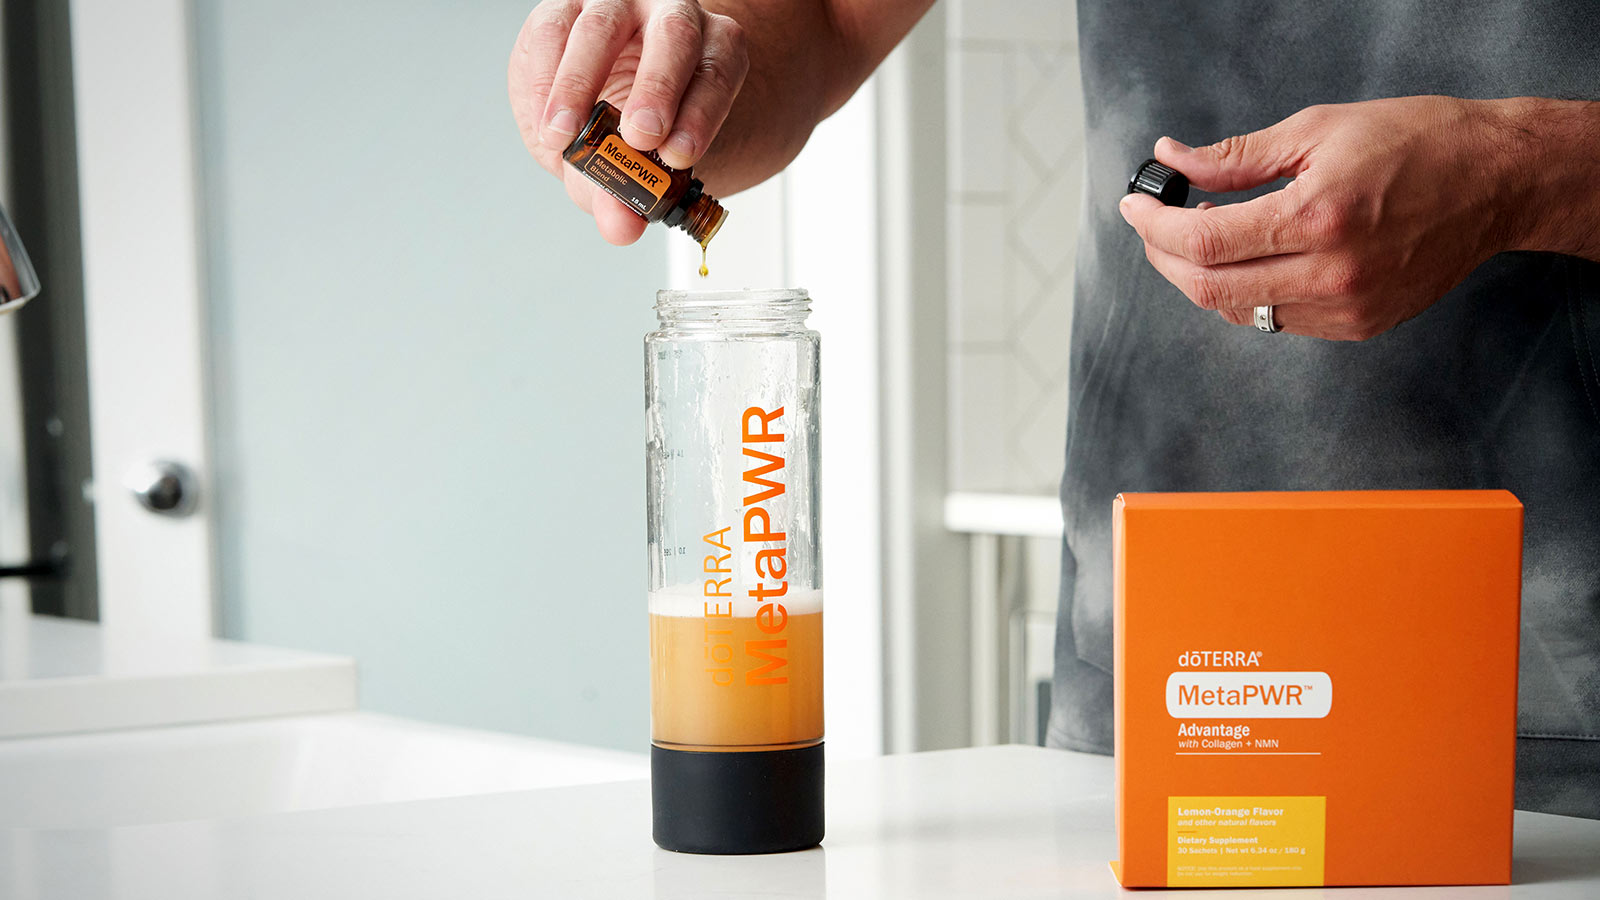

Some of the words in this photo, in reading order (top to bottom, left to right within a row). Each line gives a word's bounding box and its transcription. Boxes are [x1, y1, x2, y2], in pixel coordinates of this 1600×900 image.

[590, 165, 610, 182] Blend
[594, 158, 628, 185] Metabolic
[742, 406, 788, 686] MetaPWR
[703, 526, 734, 686] dōTERRA
[1178, 723, 1250, 739] Advantage
[1178, 740, 1199, 749] with
[1201, 739, 1243, 750] Collagen
[1255, 740, 1279, 748] NMN
[1178, 807, 1250, 817] Lemon-Orange
[1253, 807, 1284, 816] Flavor
[1249, 818, 1277, 826] flavors
[1178, 836, 1207, 846] Dietary
[1209, 836, 1259, 845] Supplement
